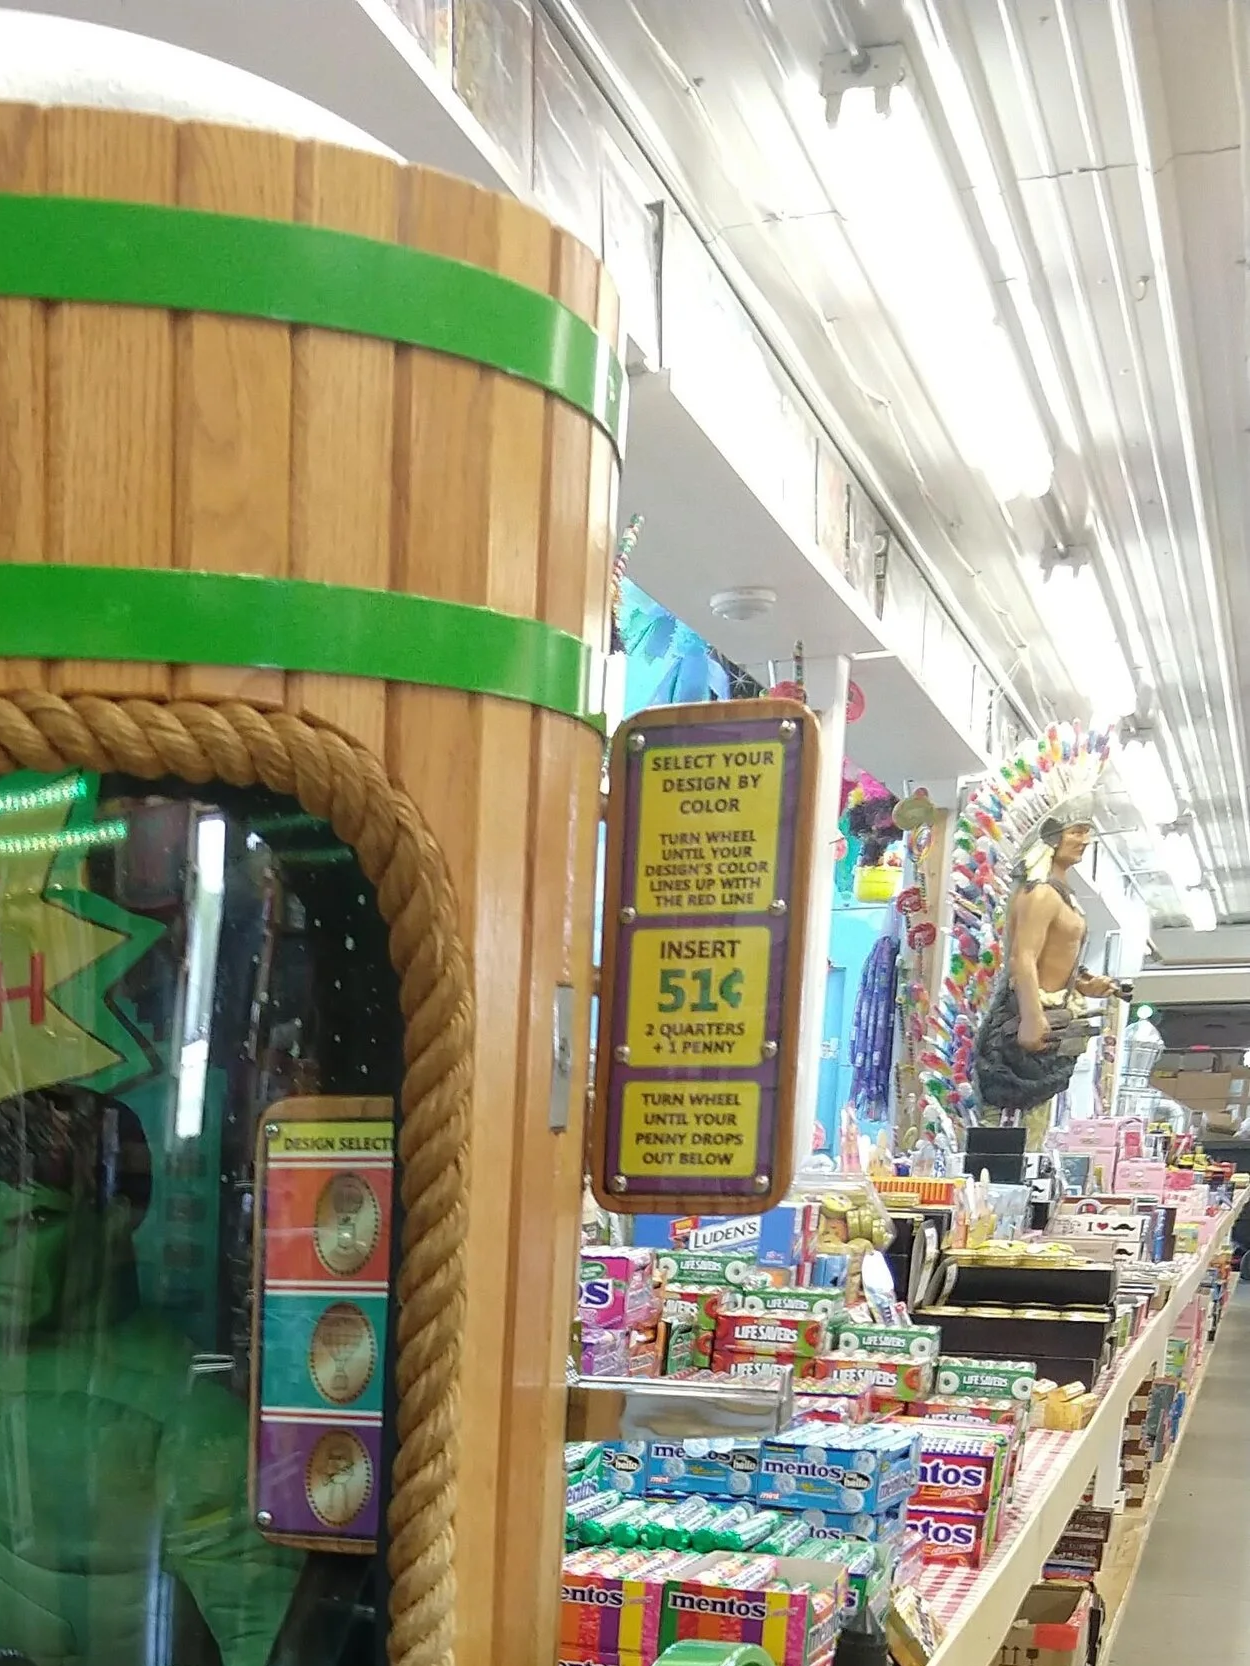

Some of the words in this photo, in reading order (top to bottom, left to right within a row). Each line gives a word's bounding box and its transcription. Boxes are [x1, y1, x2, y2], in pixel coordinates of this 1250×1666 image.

[652, 753, 717, 772] SELECT
[722, 750, 775, 768] YOUR
[662, 775, 731, 793] DESIGN
[737, 774, 762, 790] BY
[679, 798, 741, 815] COLOR
[659, 832, 701, 846] TURN
[705, 830, 757, 844] WHEEL
[661, 847, 705, 862] UNTIL
[710, 845, 753, 859] YOUR
[645, 862, 713, 877] DESIGN'S
[717, 861, 769, 875] COLOR
[650, 878, 691, 893] LINES
[695, 878, 716, 891] UP
[720, 876, 762, 890] WITH
[654, 894, 683, 908] THE
[687, 893, 716, 907] RED
[720, 892, 755, 906] LINE
[659, 940, 742, 960] INSERT
[657, 967, 745, 1013] 51¢
[645, 1023, 655, 1037] 2
[659, 1022, 746, 1039] QUARTERS
[669, 1041, 676, 1054] 1
[682, 1041, 736, 1054] PENNY
[641, 1092, 685, 1106] TURN
[689, 1092, 742, 1106] WHEEL
[644, 1112, 688, 1126] UNTIL
[693, 1112, 738, 1126] YOUR
[284, 1138, 335, 1151] DESIGN
[635, 1132, 687, 1146] PENNY
[691, 1132, 744, 1146] DROPS
[642, 1152, 675, 1165] OUT
[679, 1152, 735, 1165] BELOW
[693, 1220, 758, 1249] LUDEN'S
[1087, 1222, 1094, 1232] I
[653, 1443, 731, 1463] meos
[764, 1459, 842, 1480] mentos
[560, 1586, 624, 1606] entos
[670, 1591, 767, 1618] mentos
